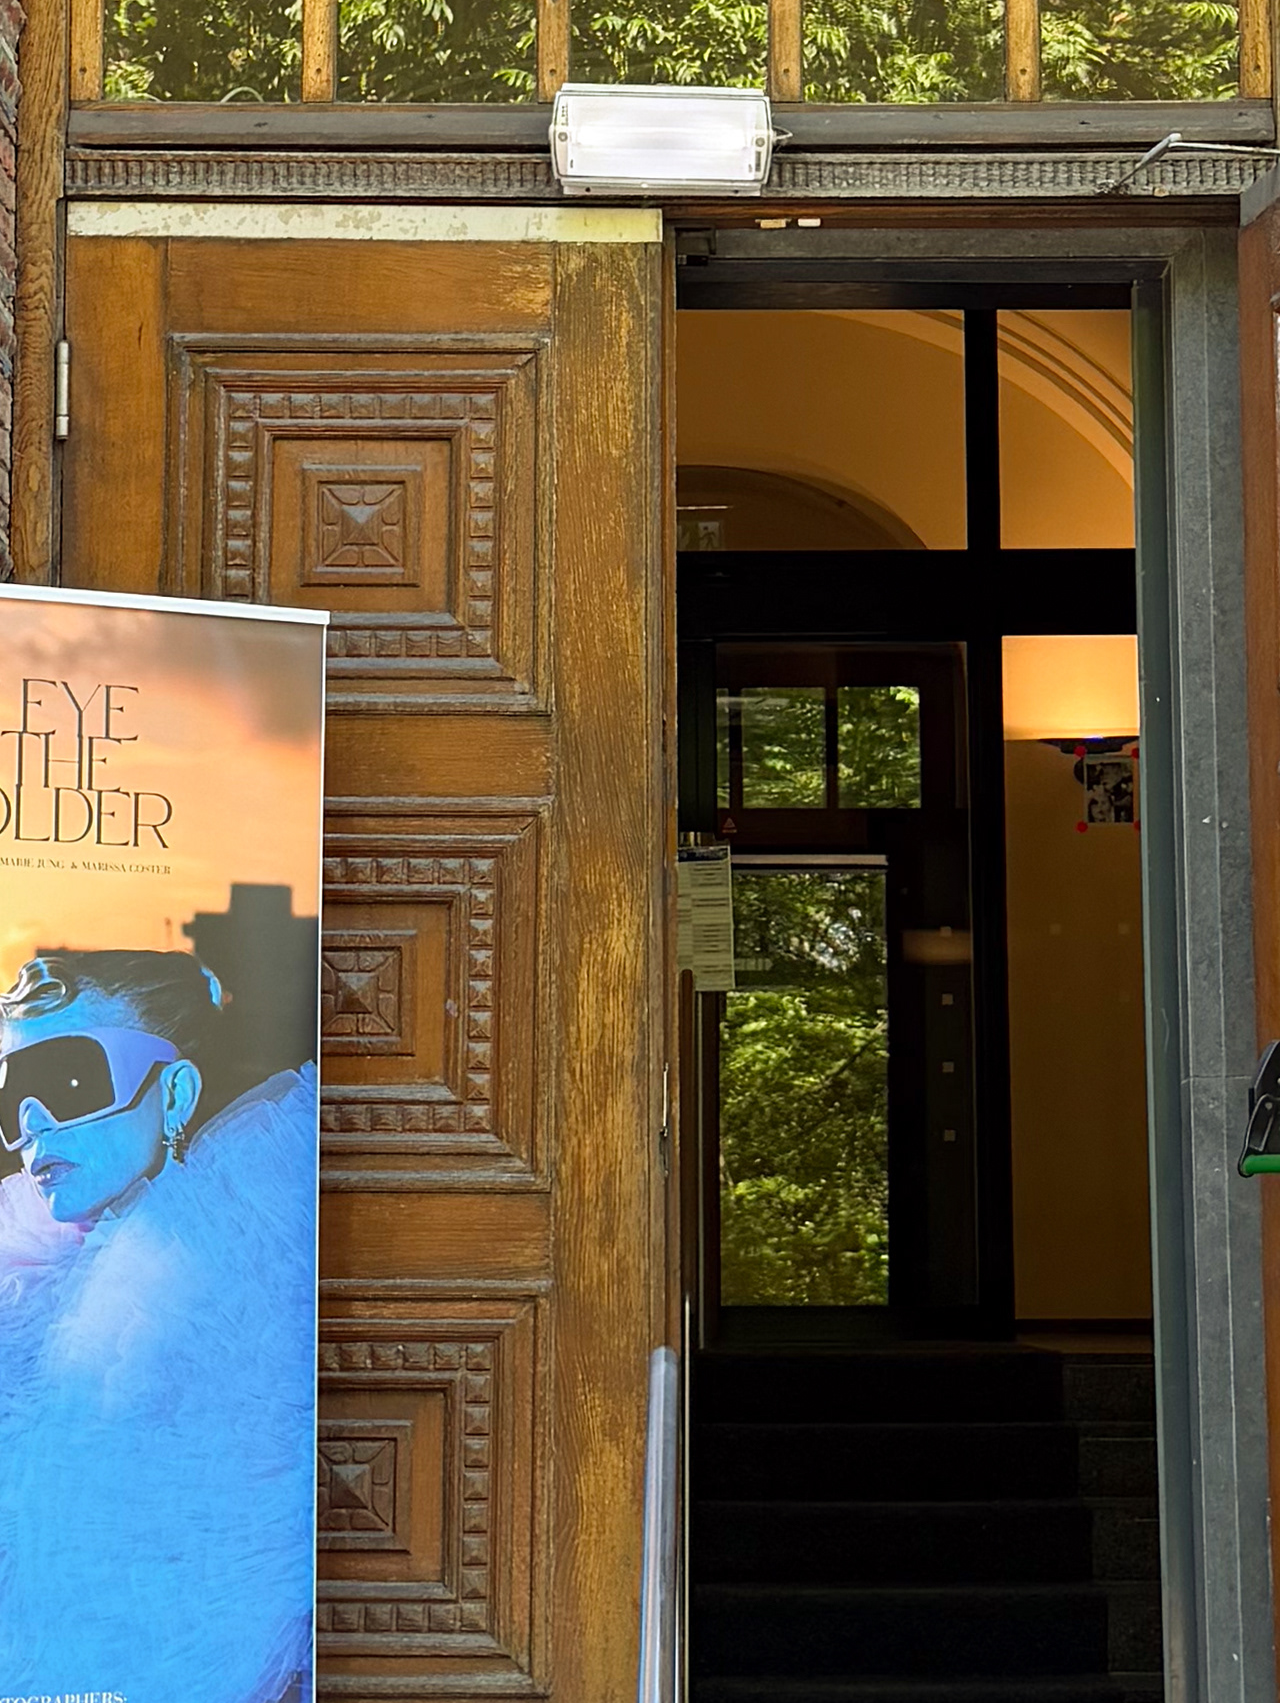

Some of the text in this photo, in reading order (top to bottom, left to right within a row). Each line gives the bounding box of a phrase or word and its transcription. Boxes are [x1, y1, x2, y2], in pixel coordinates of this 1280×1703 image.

[22, 678, 139, 741] EYE
[0, 730, 122, 792] THE
[70, 861, 78, 870] &
[82, 861, 127, 873] MARISSA
